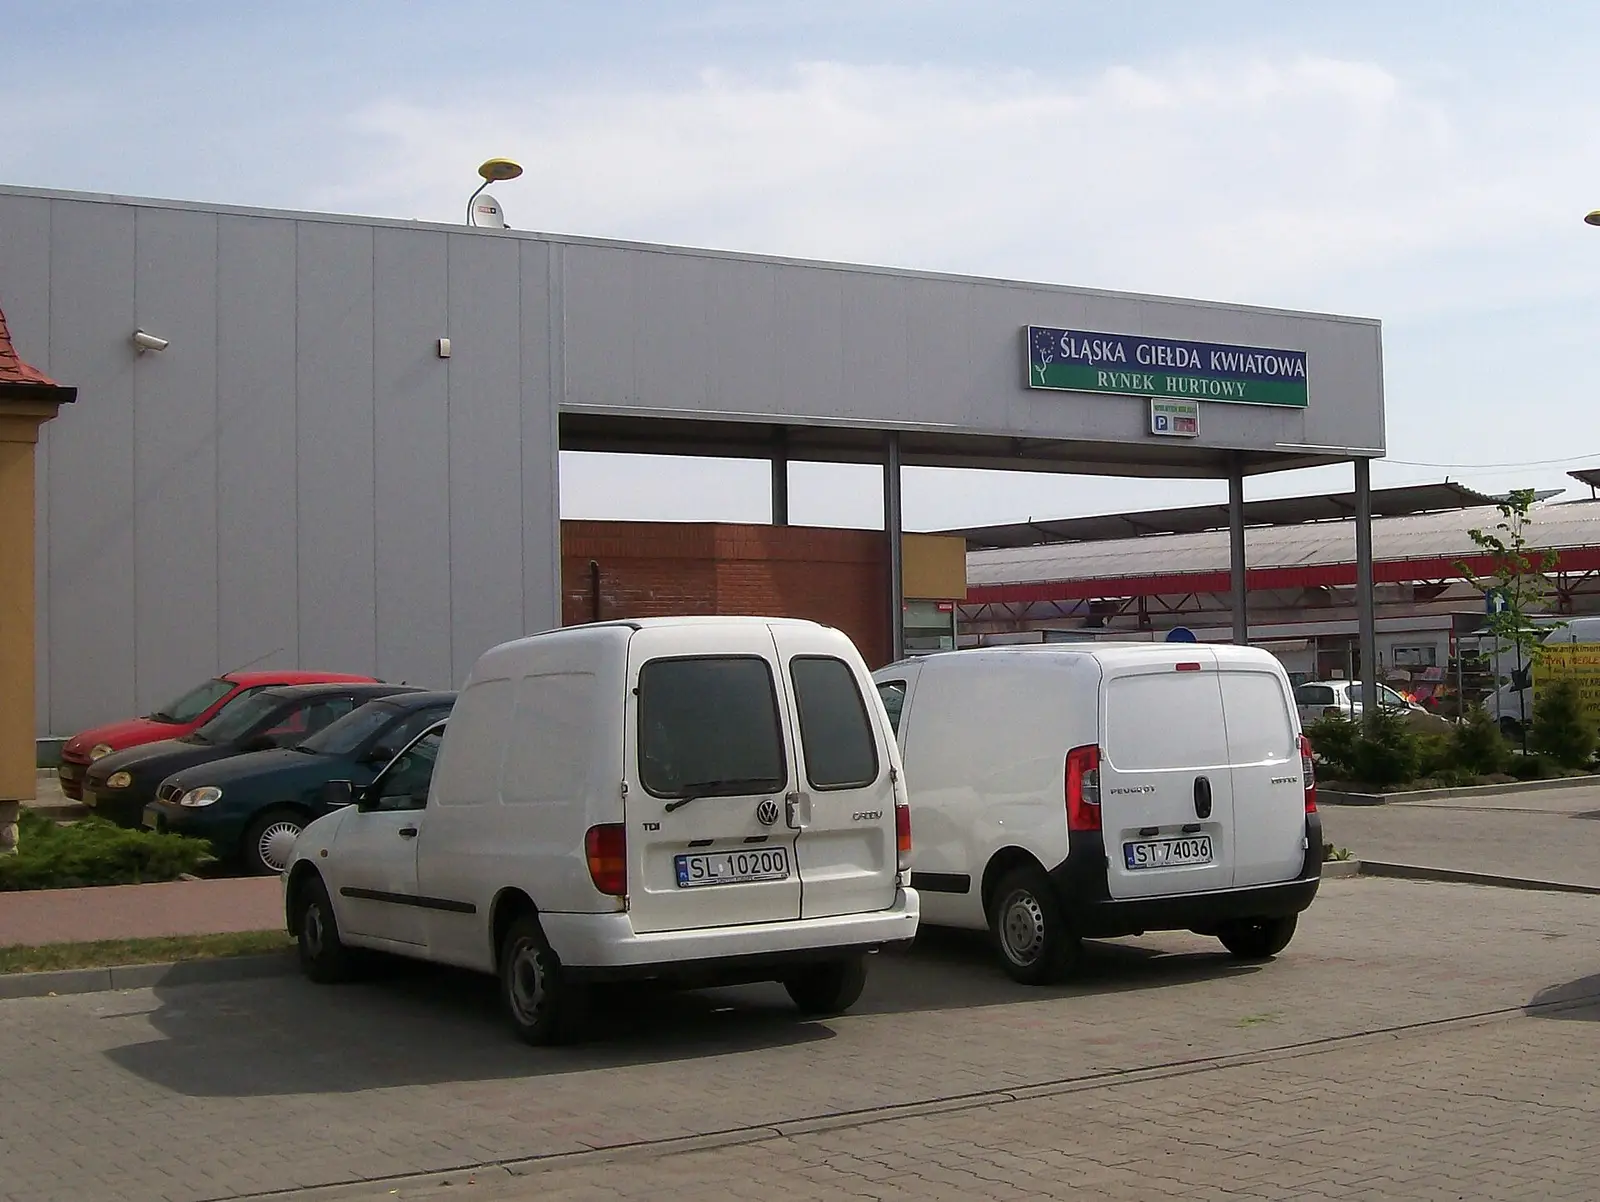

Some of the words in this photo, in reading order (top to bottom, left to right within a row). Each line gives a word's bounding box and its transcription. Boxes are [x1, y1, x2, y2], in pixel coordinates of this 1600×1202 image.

[1060, 331, 1126, 365] ŚLĄSKA
[1136, 344, 1201, 369] GIEŁDA
[1210, 352, 1305, 377] KWIATOWA
[1097, 371, 1154, 391] RYNEK
[1166, 377, 1247, 397] HURTOWY
[1109, 785, 1155, 795] PEUGEOT
[642, 822, 660, 831] TDI
[1136, 843, 1157, 862] ST
[1163, 840, 1208, 860] 74036
[690, 857, 718, 878] SL
[727, 852, 784, 876] 10200
